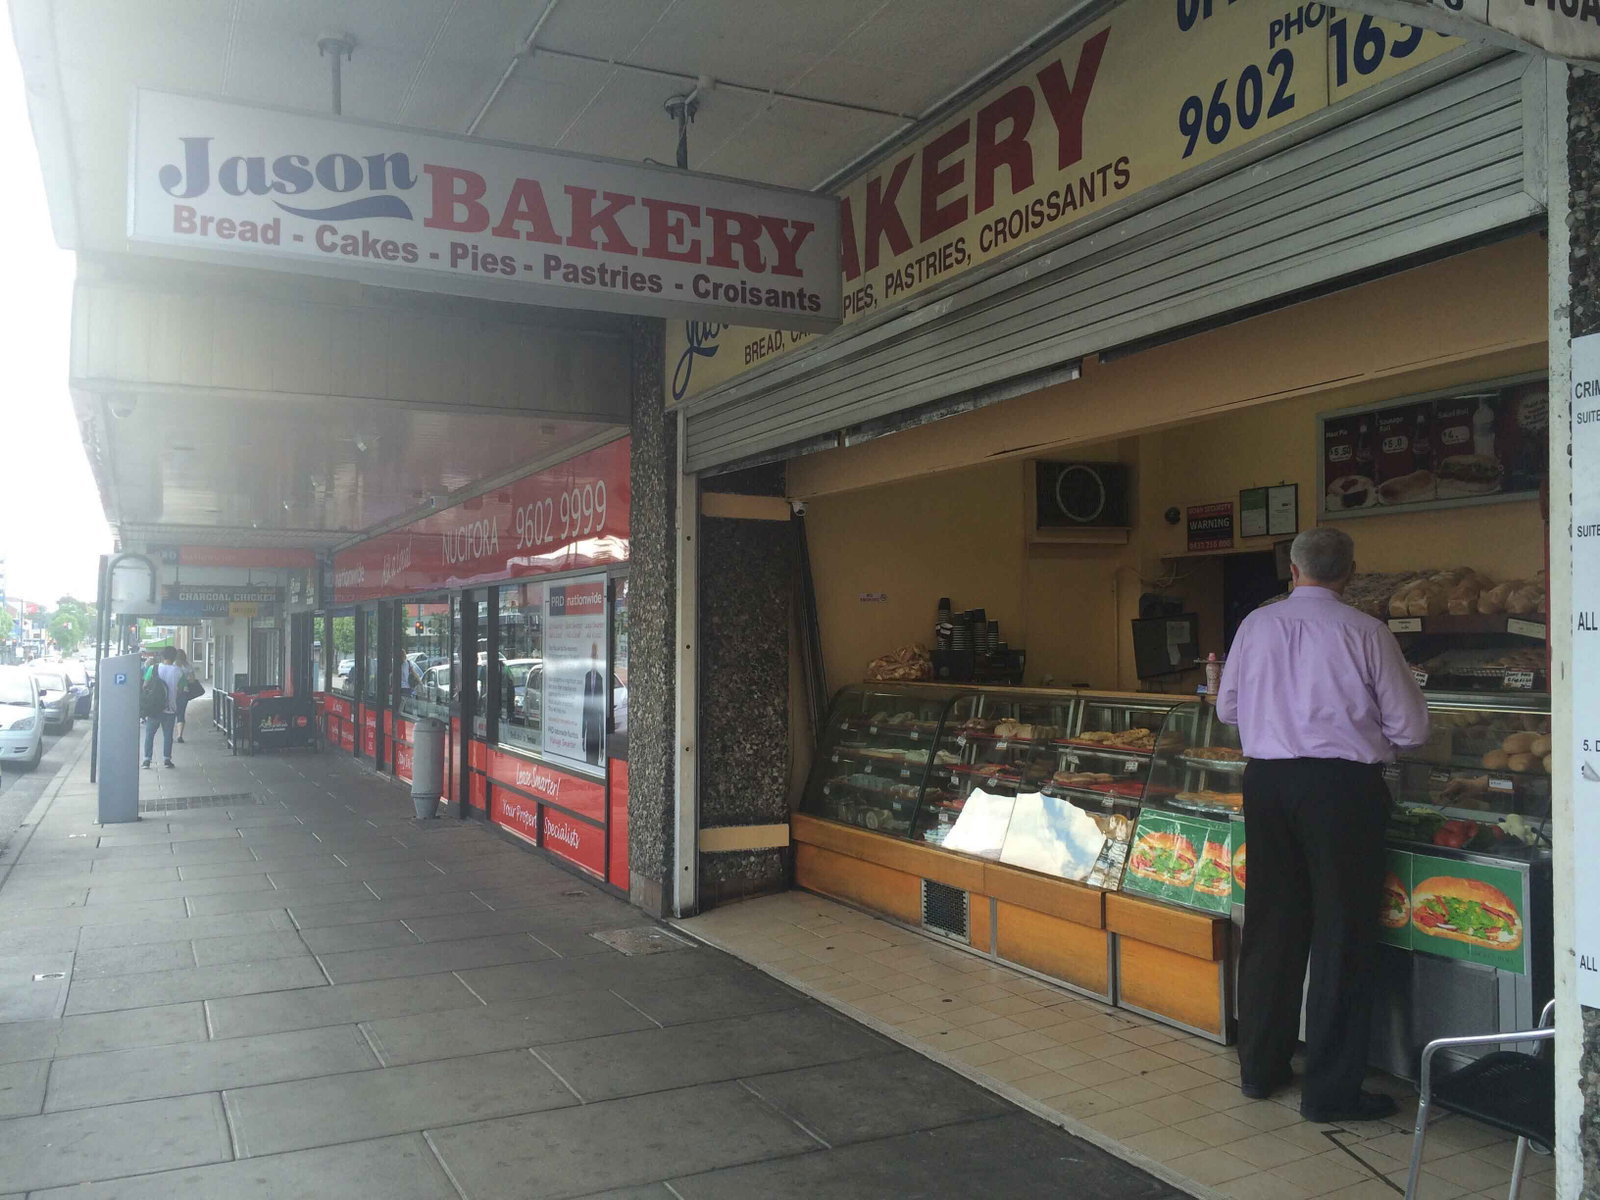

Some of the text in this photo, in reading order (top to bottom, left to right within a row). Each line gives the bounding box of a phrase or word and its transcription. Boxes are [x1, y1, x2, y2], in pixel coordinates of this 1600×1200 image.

[1268, 3, 1336, 49] PHO
[1178, 48, 1296, 160] 9602
[841, 27, 1111, 283] AKERY
[158, 136, 816, 278] Jason BAKERY
[173, 204, 281, 246] Bread
[315, 224, 419, 264] Cakes
[450, 242, 518, 276] Pies
[543, 252, 664, 295] Pastries
[692, 273, 822, 313] Croisants
[744, 330, 786, 365] BREAD,
[843, 283, 878, 319] PIES,
[885, 237, 972, 298] PASTRIES,
[979, 155, 1131, 254] CROISSANTS
[442, 480, 607, 566] NUCIFORA 9602 9999
[1189, 518, 1230, 530] WARNING
[179, 592, 276, 601] CHARCOAL CHICKEN
[566, 592, 603, 606] nationwide
[1577, 612, 1599, 631] ALL
[516, 805, 538, 831] Propert
[543, 817, 581, 849] Specialists
[1580, 955, 1598, 972] ALL
